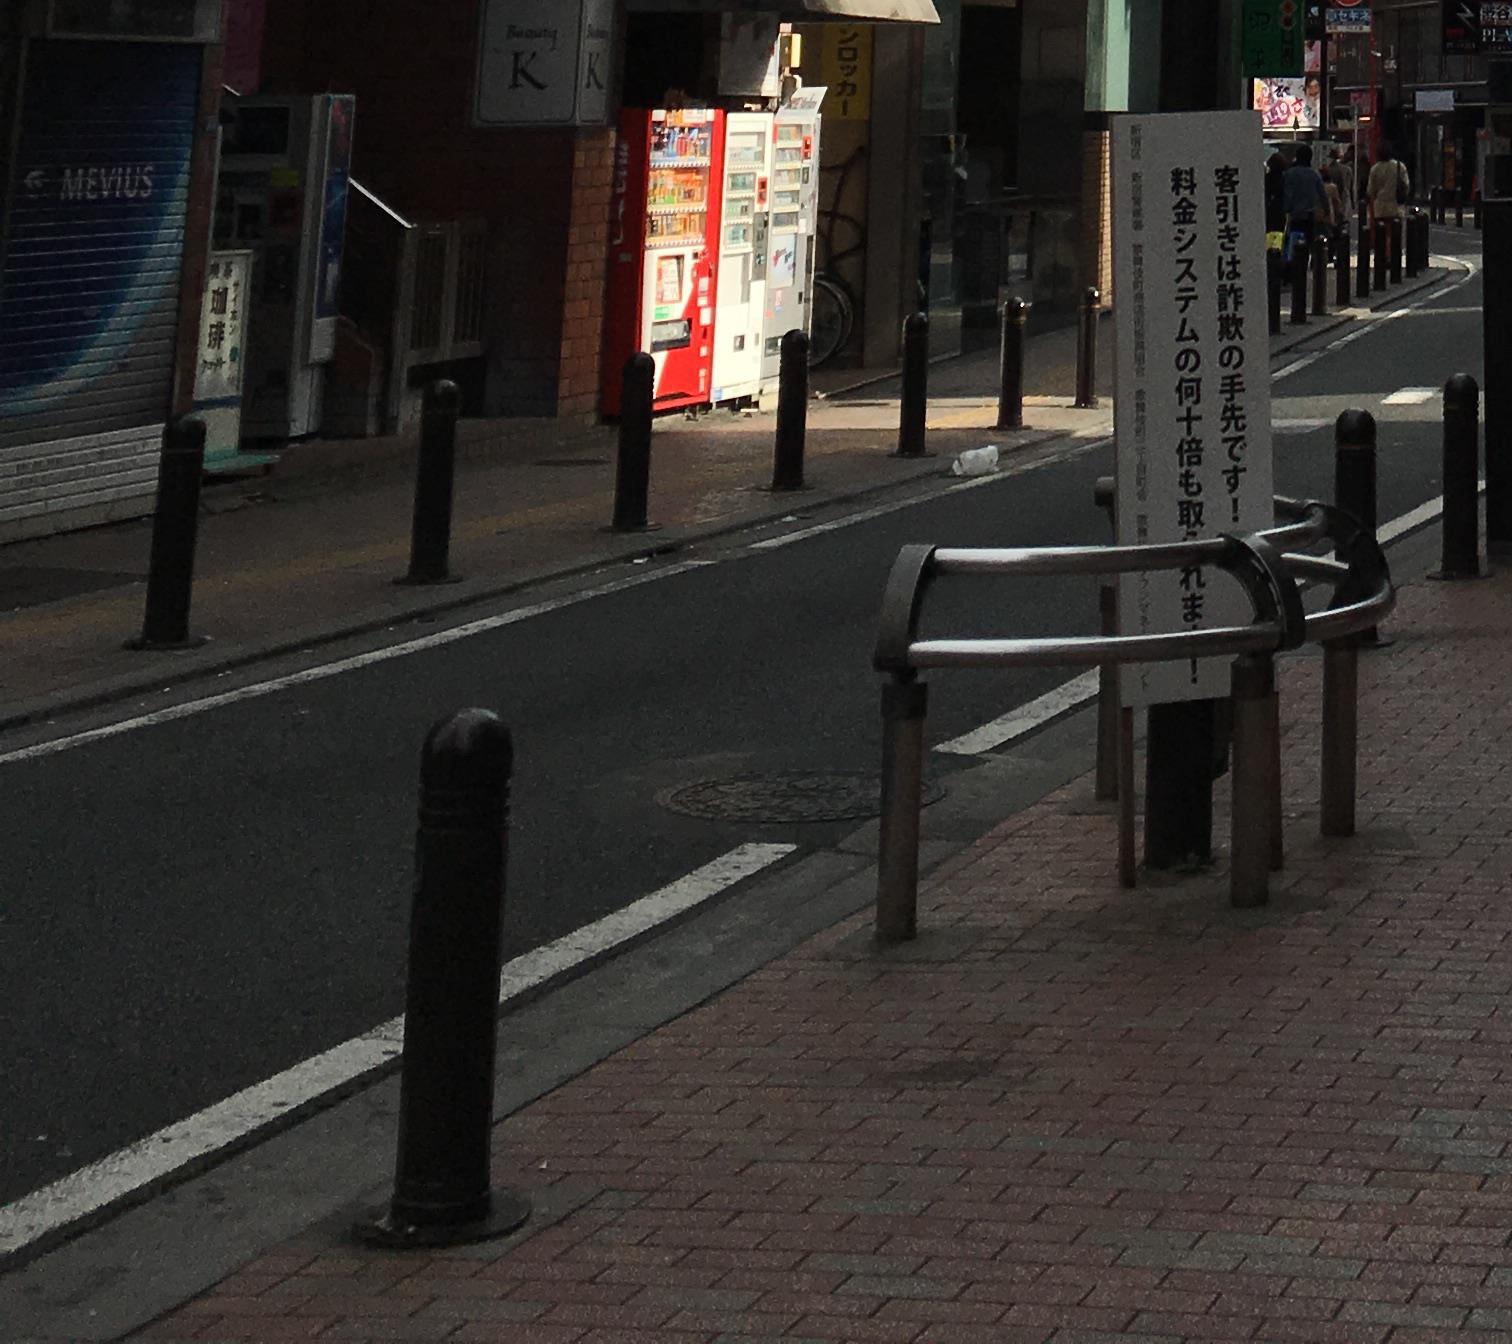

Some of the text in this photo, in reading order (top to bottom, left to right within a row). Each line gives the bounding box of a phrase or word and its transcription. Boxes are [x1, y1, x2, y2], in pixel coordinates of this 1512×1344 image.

[508, 52, 548, 90] K
[59, 165, 155, 201] MEVIUS
[1213, 165, 1248, 523] 客引きは詐欺の手先です！
